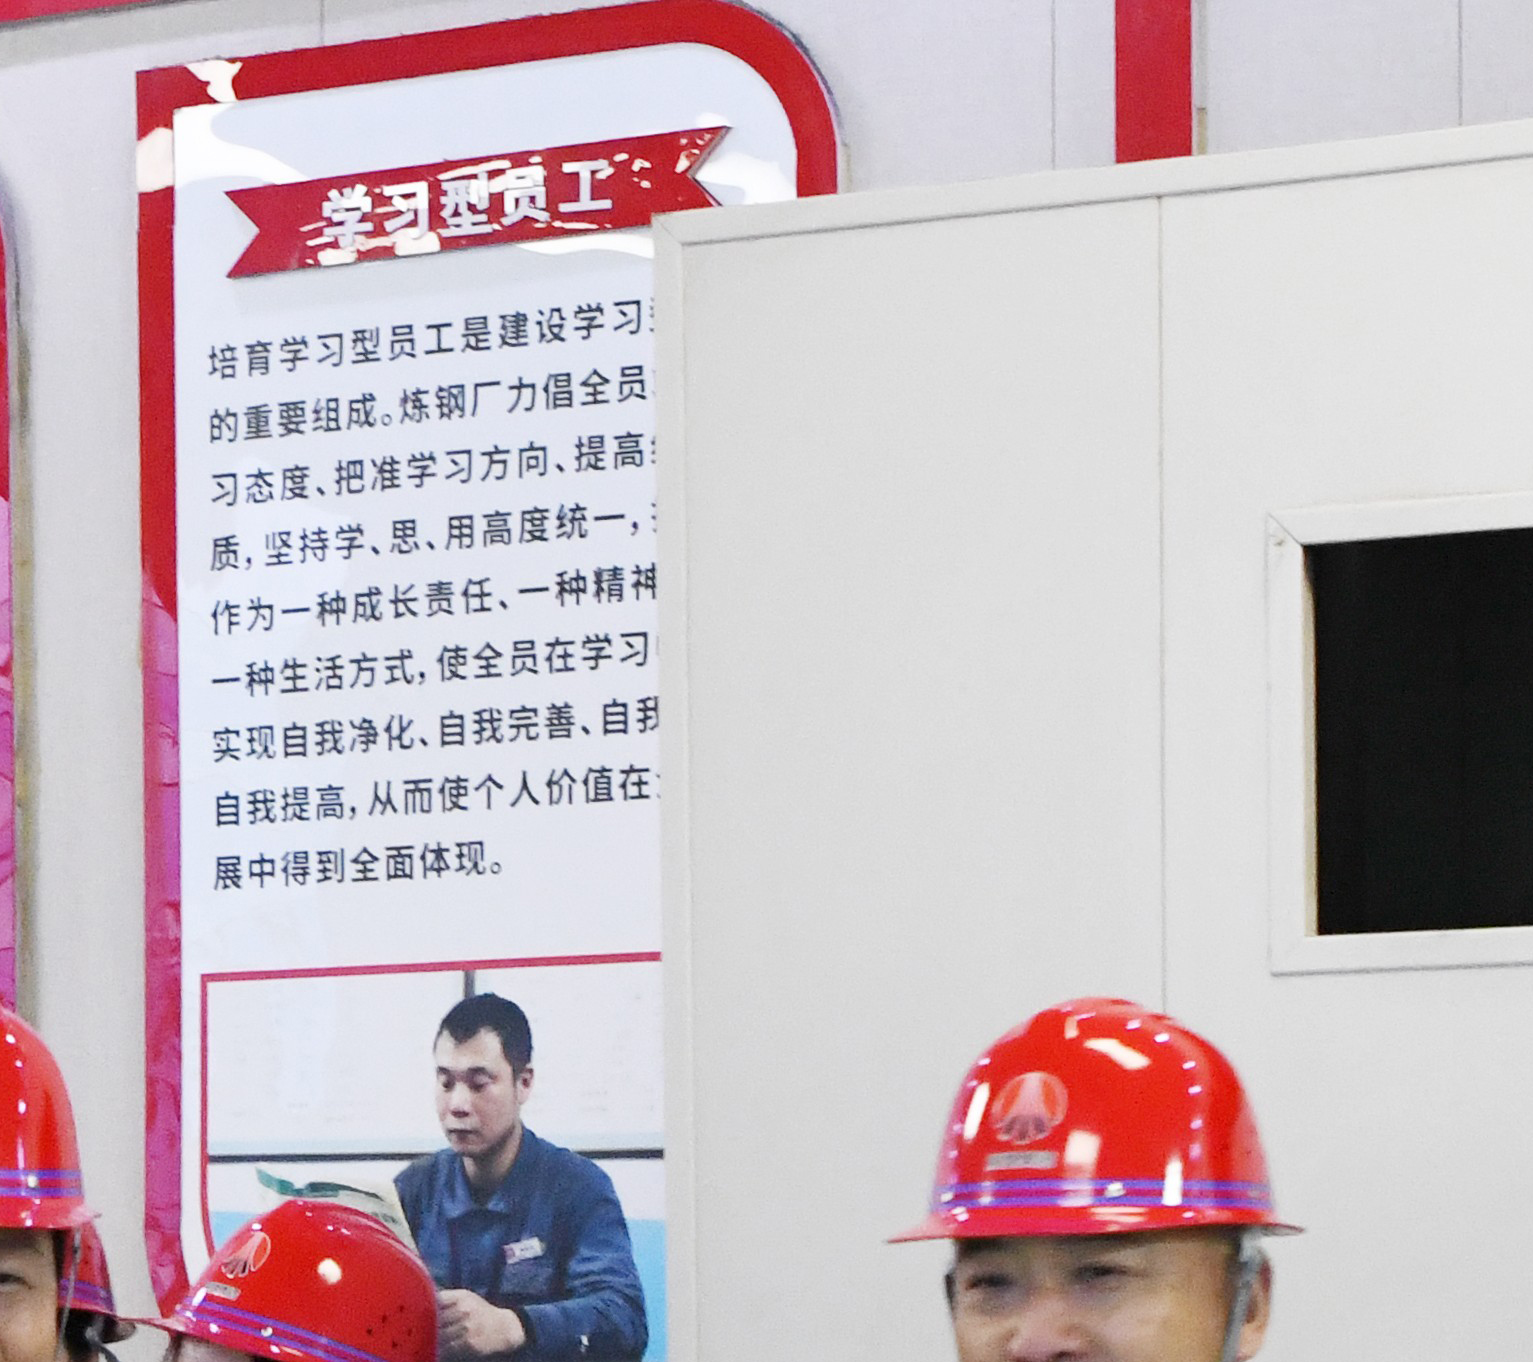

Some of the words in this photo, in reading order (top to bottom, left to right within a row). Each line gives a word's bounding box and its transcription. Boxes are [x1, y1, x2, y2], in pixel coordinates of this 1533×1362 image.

[321, 159, 614, 248] 学习型员工
[208, 299, 655, 380] 培育学习型员工是建设学习
[211, 431, 656, 507] 习态度、把准学习方向、提高
[210, 502, 657, 572] 质，坚持学、思、用高度统一，
[215, 763, 661, 828] 自我提高，从而使个人价值在
